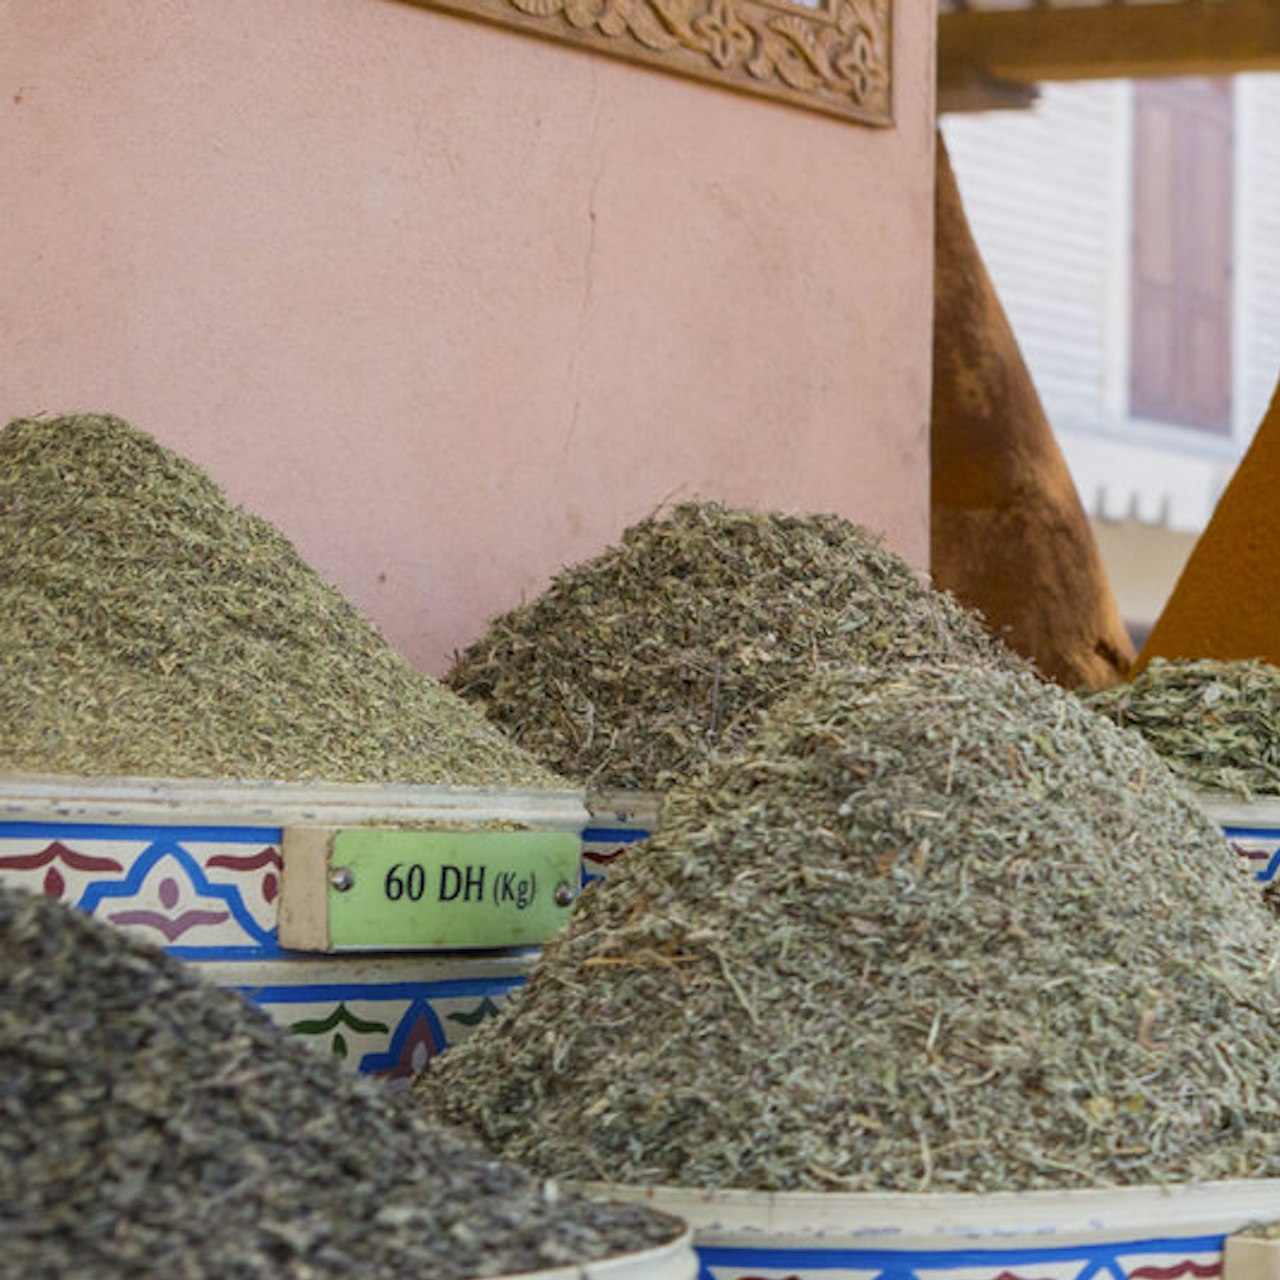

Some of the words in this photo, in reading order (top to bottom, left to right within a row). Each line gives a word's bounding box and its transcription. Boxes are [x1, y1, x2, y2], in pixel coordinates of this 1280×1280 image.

[385, 863, 426, 902] 60
[438, 864, 487, 902] DH
[493, 871, 537, 910] (Kg)
